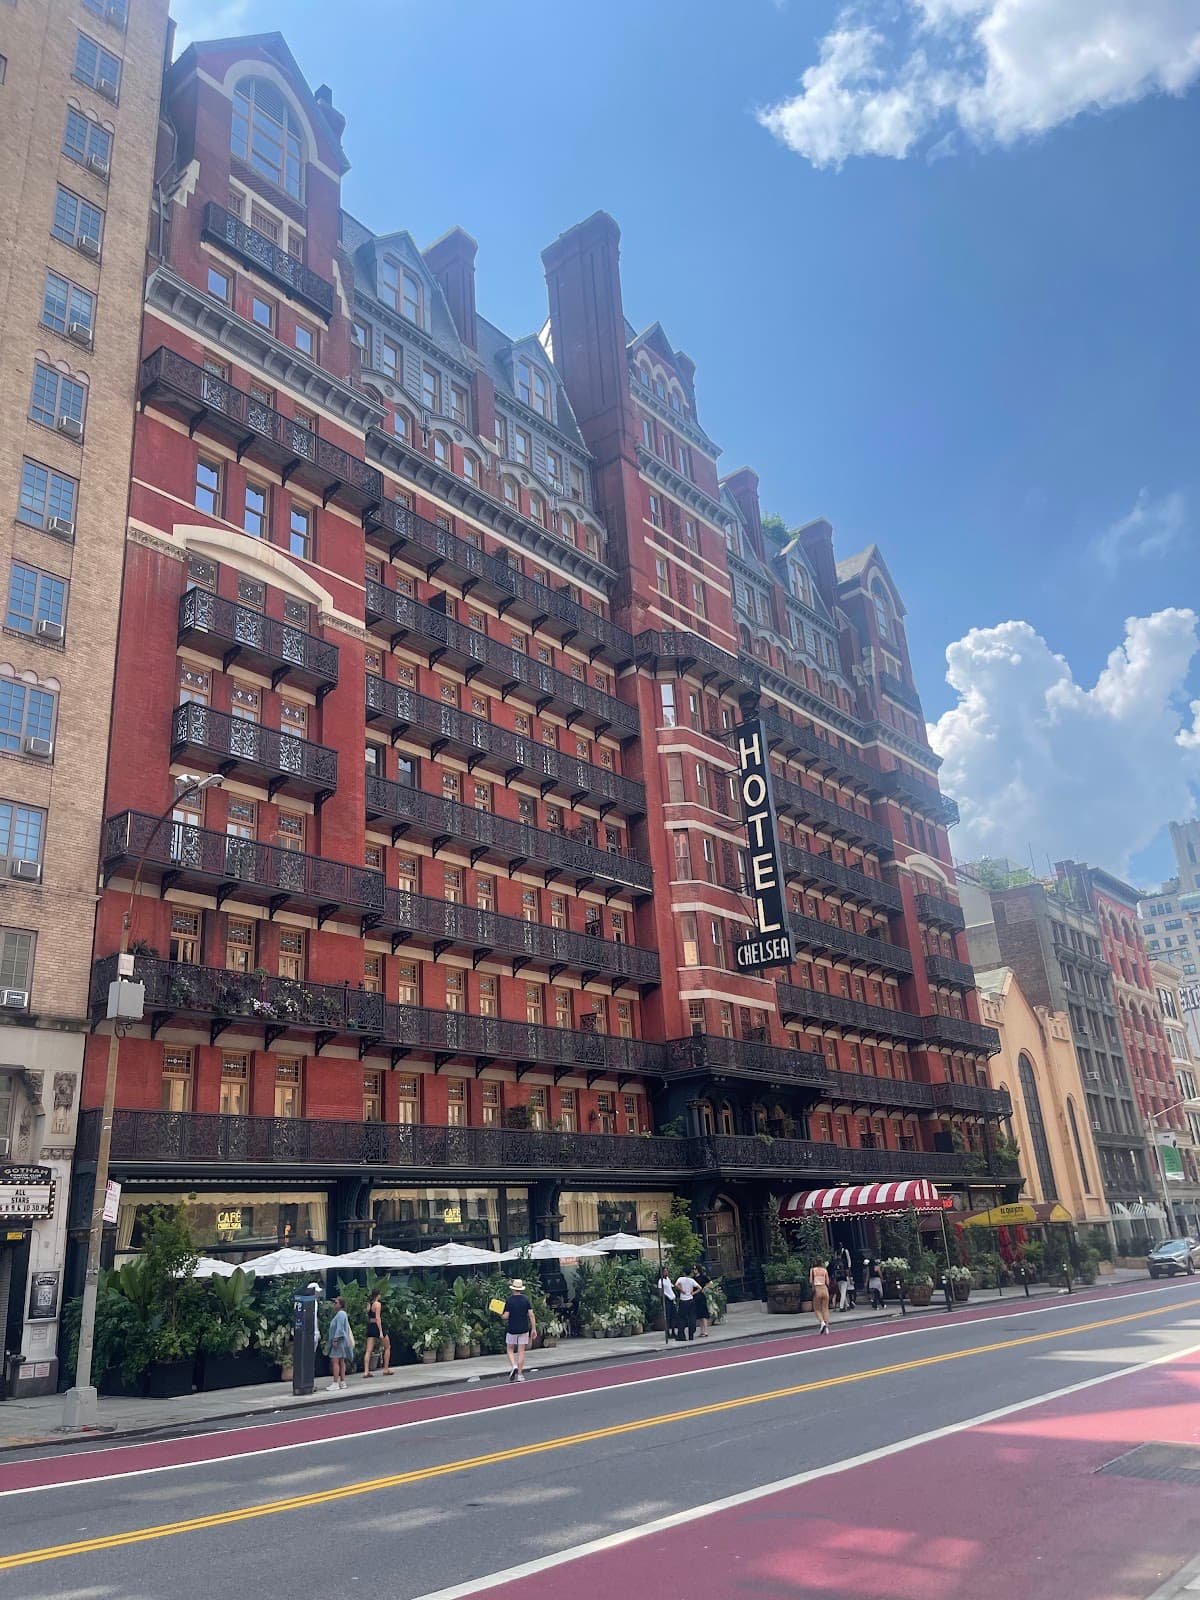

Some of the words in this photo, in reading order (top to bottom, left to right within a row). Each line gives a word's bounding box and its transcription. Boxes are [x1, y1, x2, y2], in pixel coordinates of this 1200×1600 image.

[739, 732, 781, 934] HOTEL
[737, 937, 790, 966] CHELSEA
[4, 1167, 48, 1175] GOTHAM
[217, 1208, 241, 1223] CAFÉ
